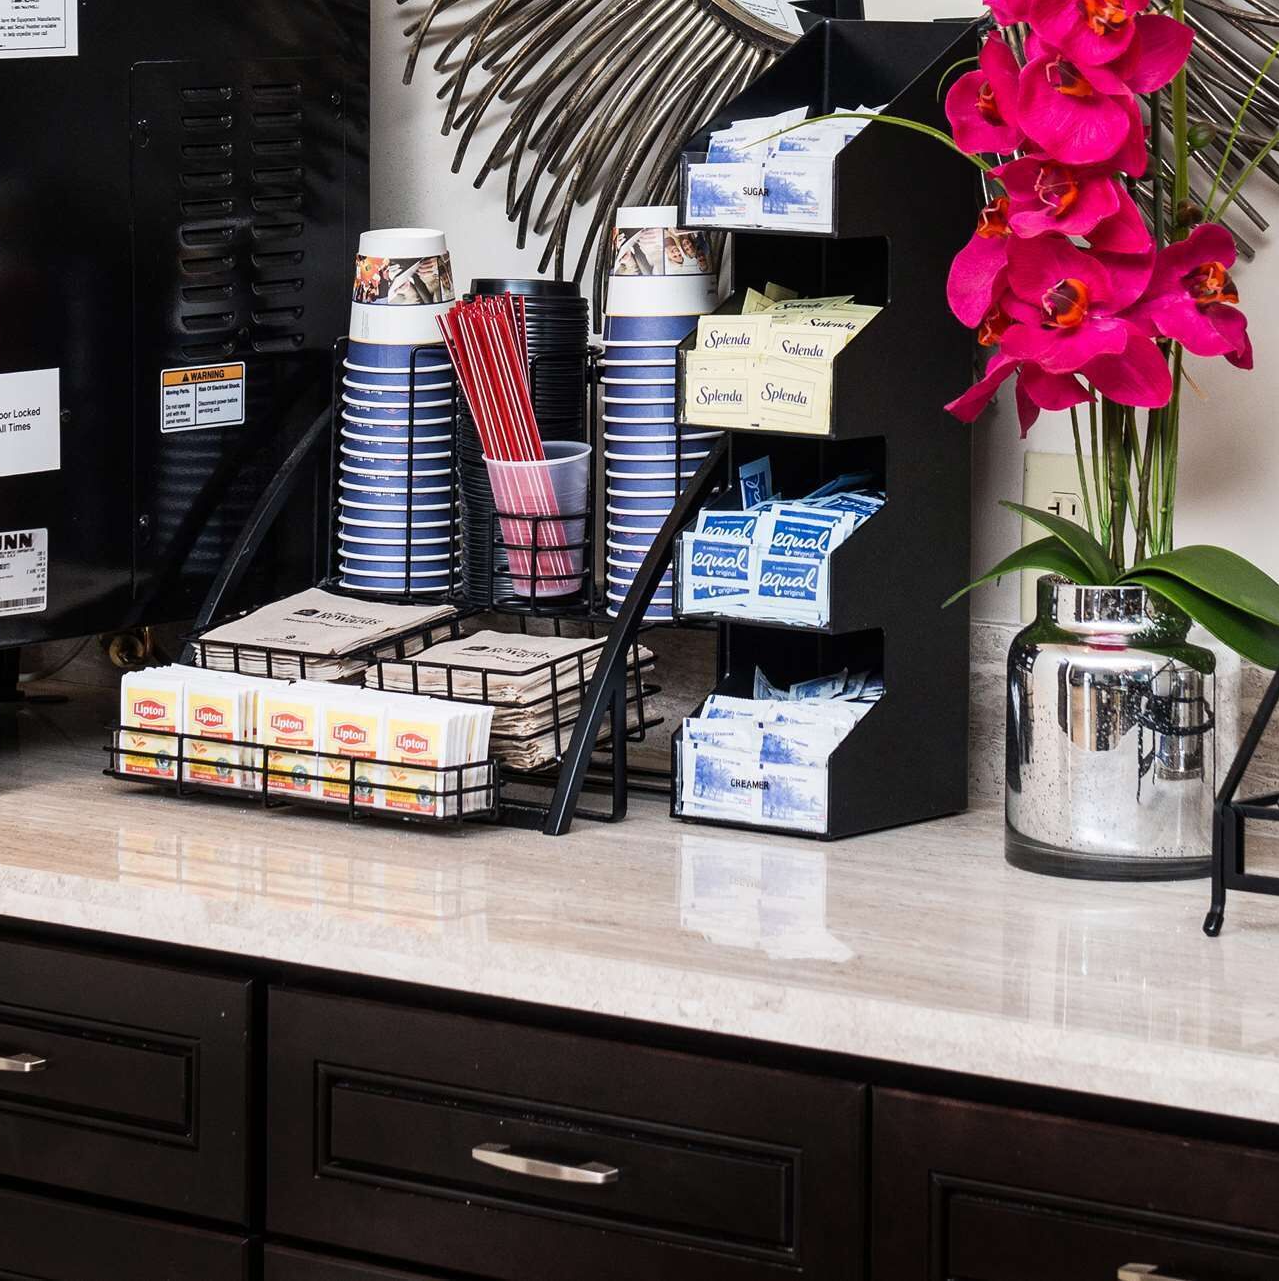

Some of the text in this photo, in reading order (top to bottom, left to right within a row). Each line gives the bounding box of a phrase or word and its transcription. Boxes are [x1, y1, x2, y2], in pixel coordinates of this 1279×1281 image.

[743, 187, 768, 197] SUGAR
[705, 330, 751, 350] Splenda
[782, 340, 824, 357] Splenda
[191, 369, 224, 380] WARNING
[696, 386, 743, 405] Splenda
[761, 382, 807, 405] Splenda
[13, 407, 40, 418] Locked
[8, 423, 31, 432] Times
[771, 531, 830, 556] equal
[692, 548, 749, 575] equal
[715, 570, 737, 578] original
[759, 564, 817, 596] equal
[784, 589, 805, 598] original
[135, 703, 165, 716] Lipton
[196, 710, 223, 723] Lipton
[272, 717, 303, 731] Lipton
[334, 727, 365, 742] Lipton
[397, 736, 427, 750] Lipton
[730, 778, 769, 790] CREAMER
